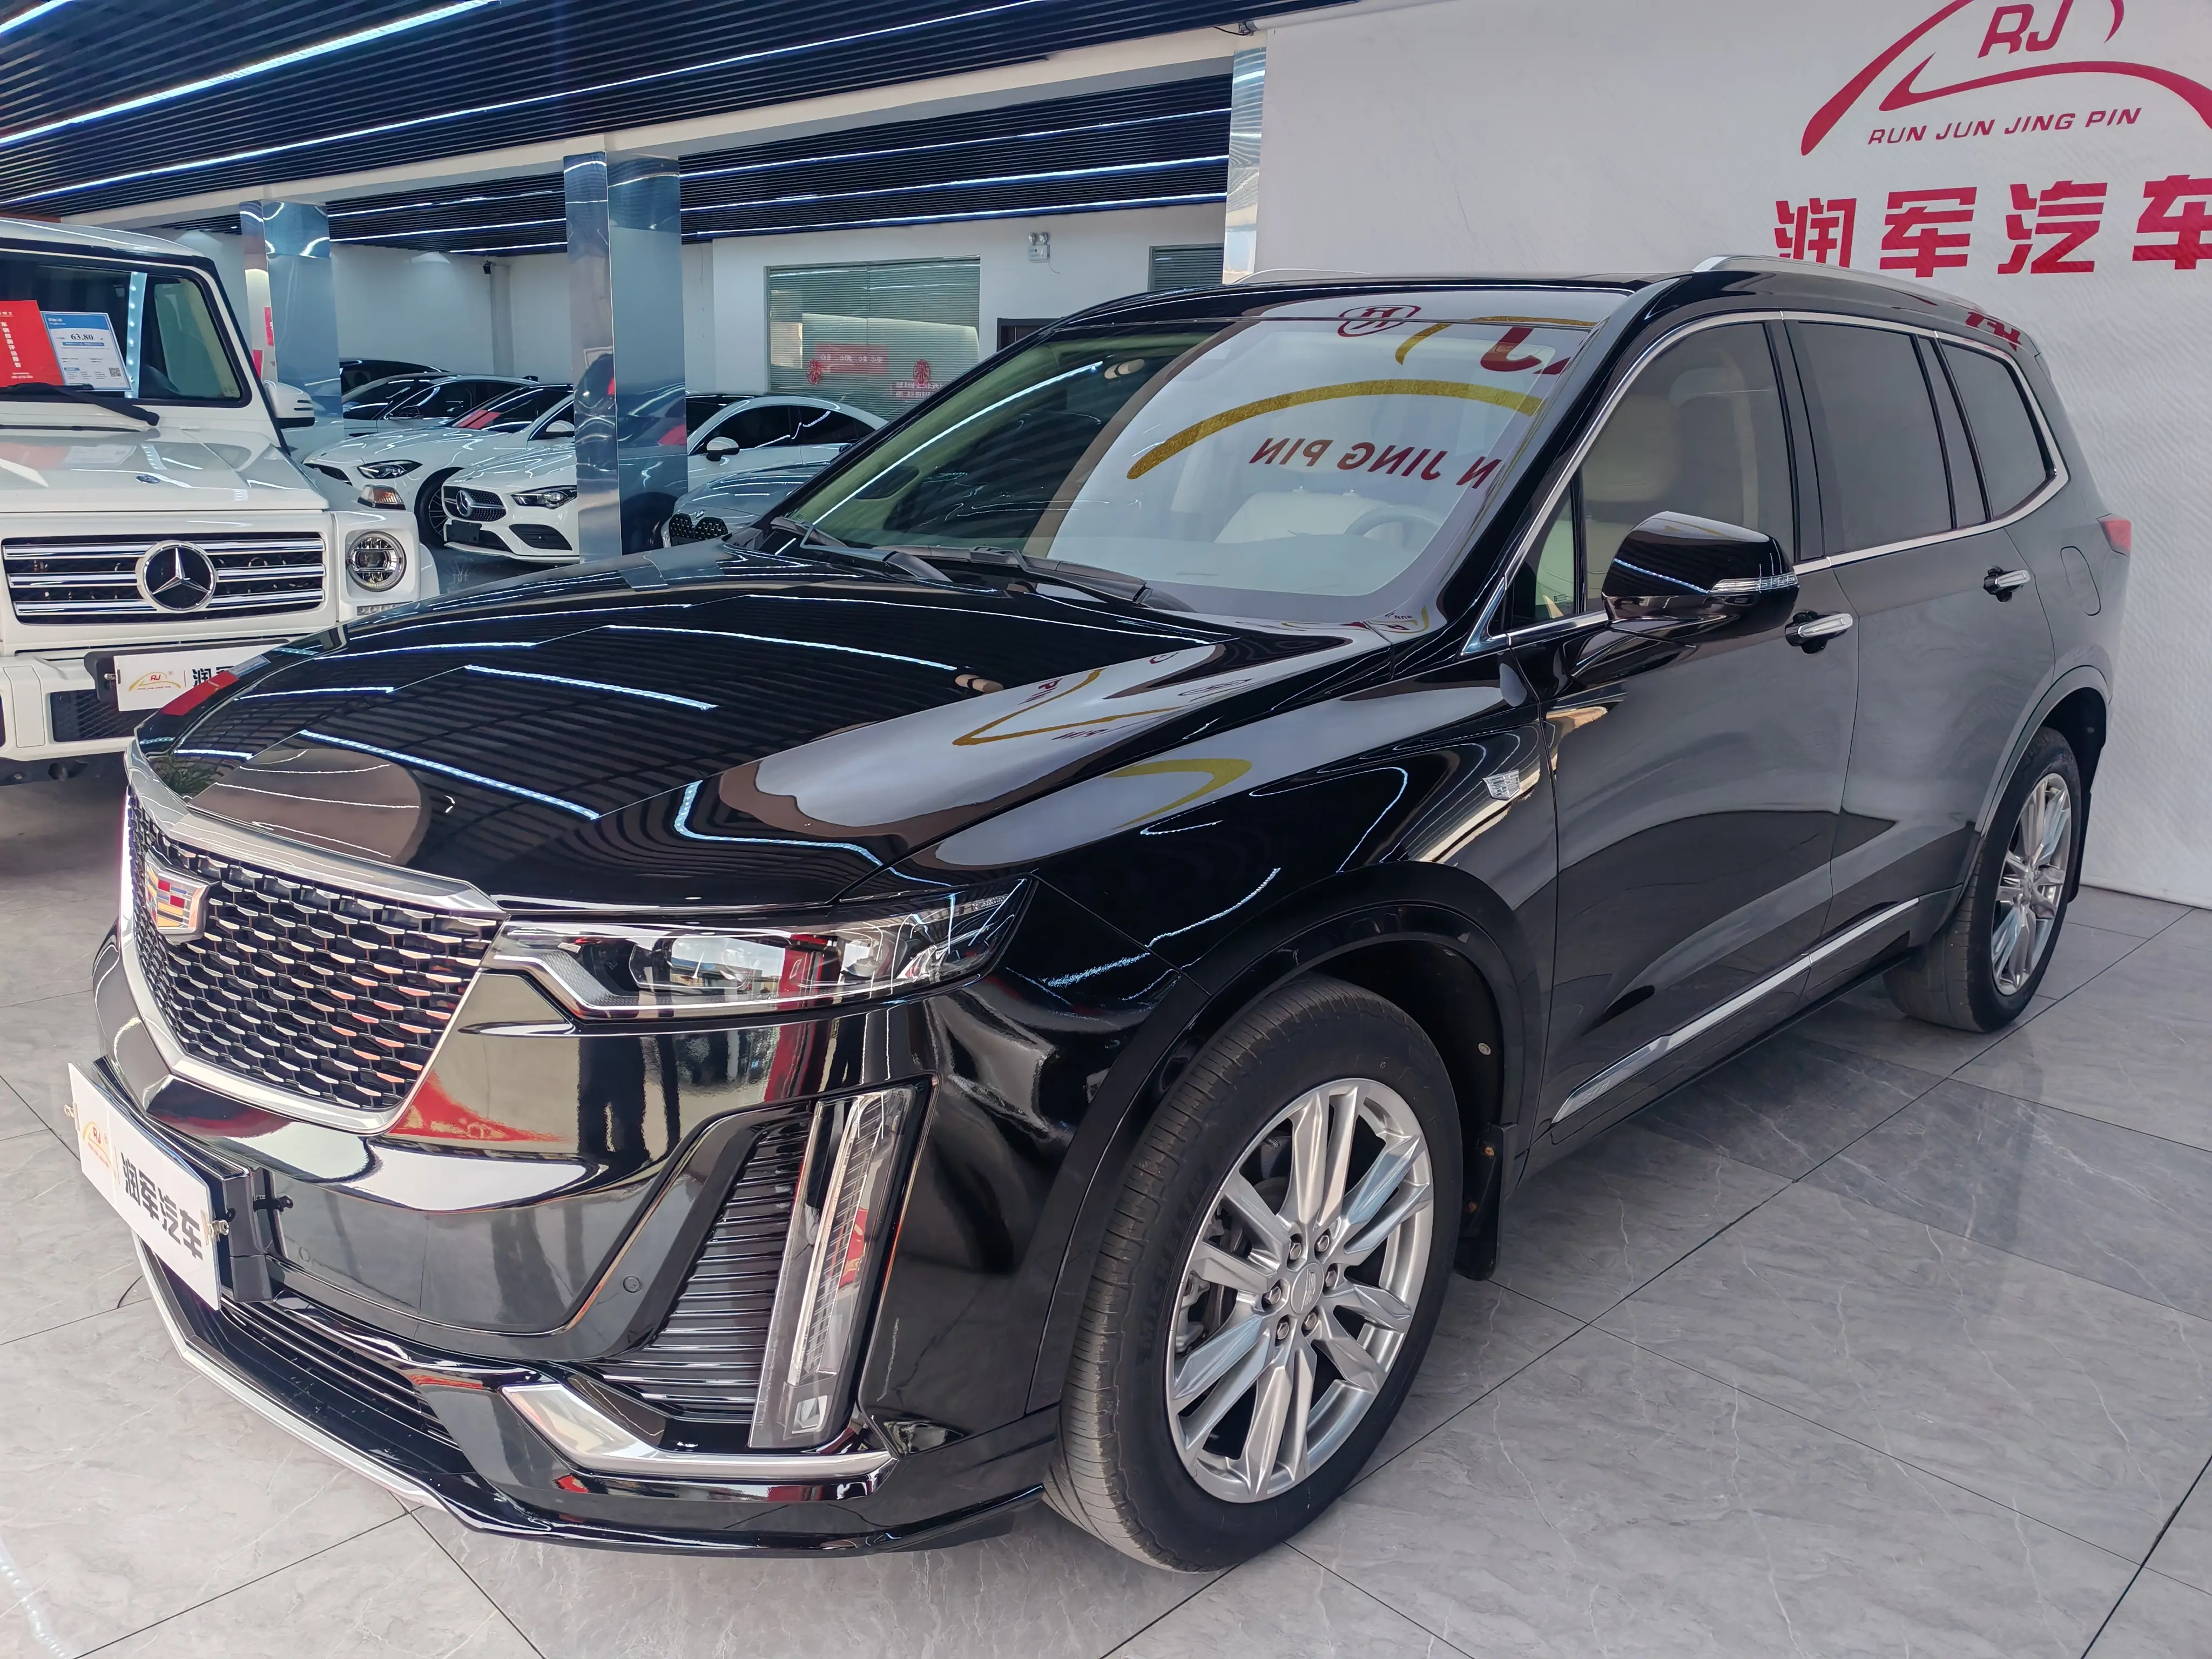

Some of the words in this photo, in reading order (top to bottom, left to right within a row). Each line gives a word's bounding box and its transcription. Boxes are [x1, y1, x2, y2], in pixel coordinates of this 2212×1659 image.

[1977, 0, 2072, 58] RJ
[1867, 125, 1926, 145] RUN
[1936, 119, 1995, 140] JUN
[2004, 112, 2075, 135] JING
[2085, 107, 2142, 127] PIN
[1775, 174, 2212, 278] 润军汽车
[93, 1126, 101, 1144] RJ
[120, 1151, 204, 1260] 润军汽车
